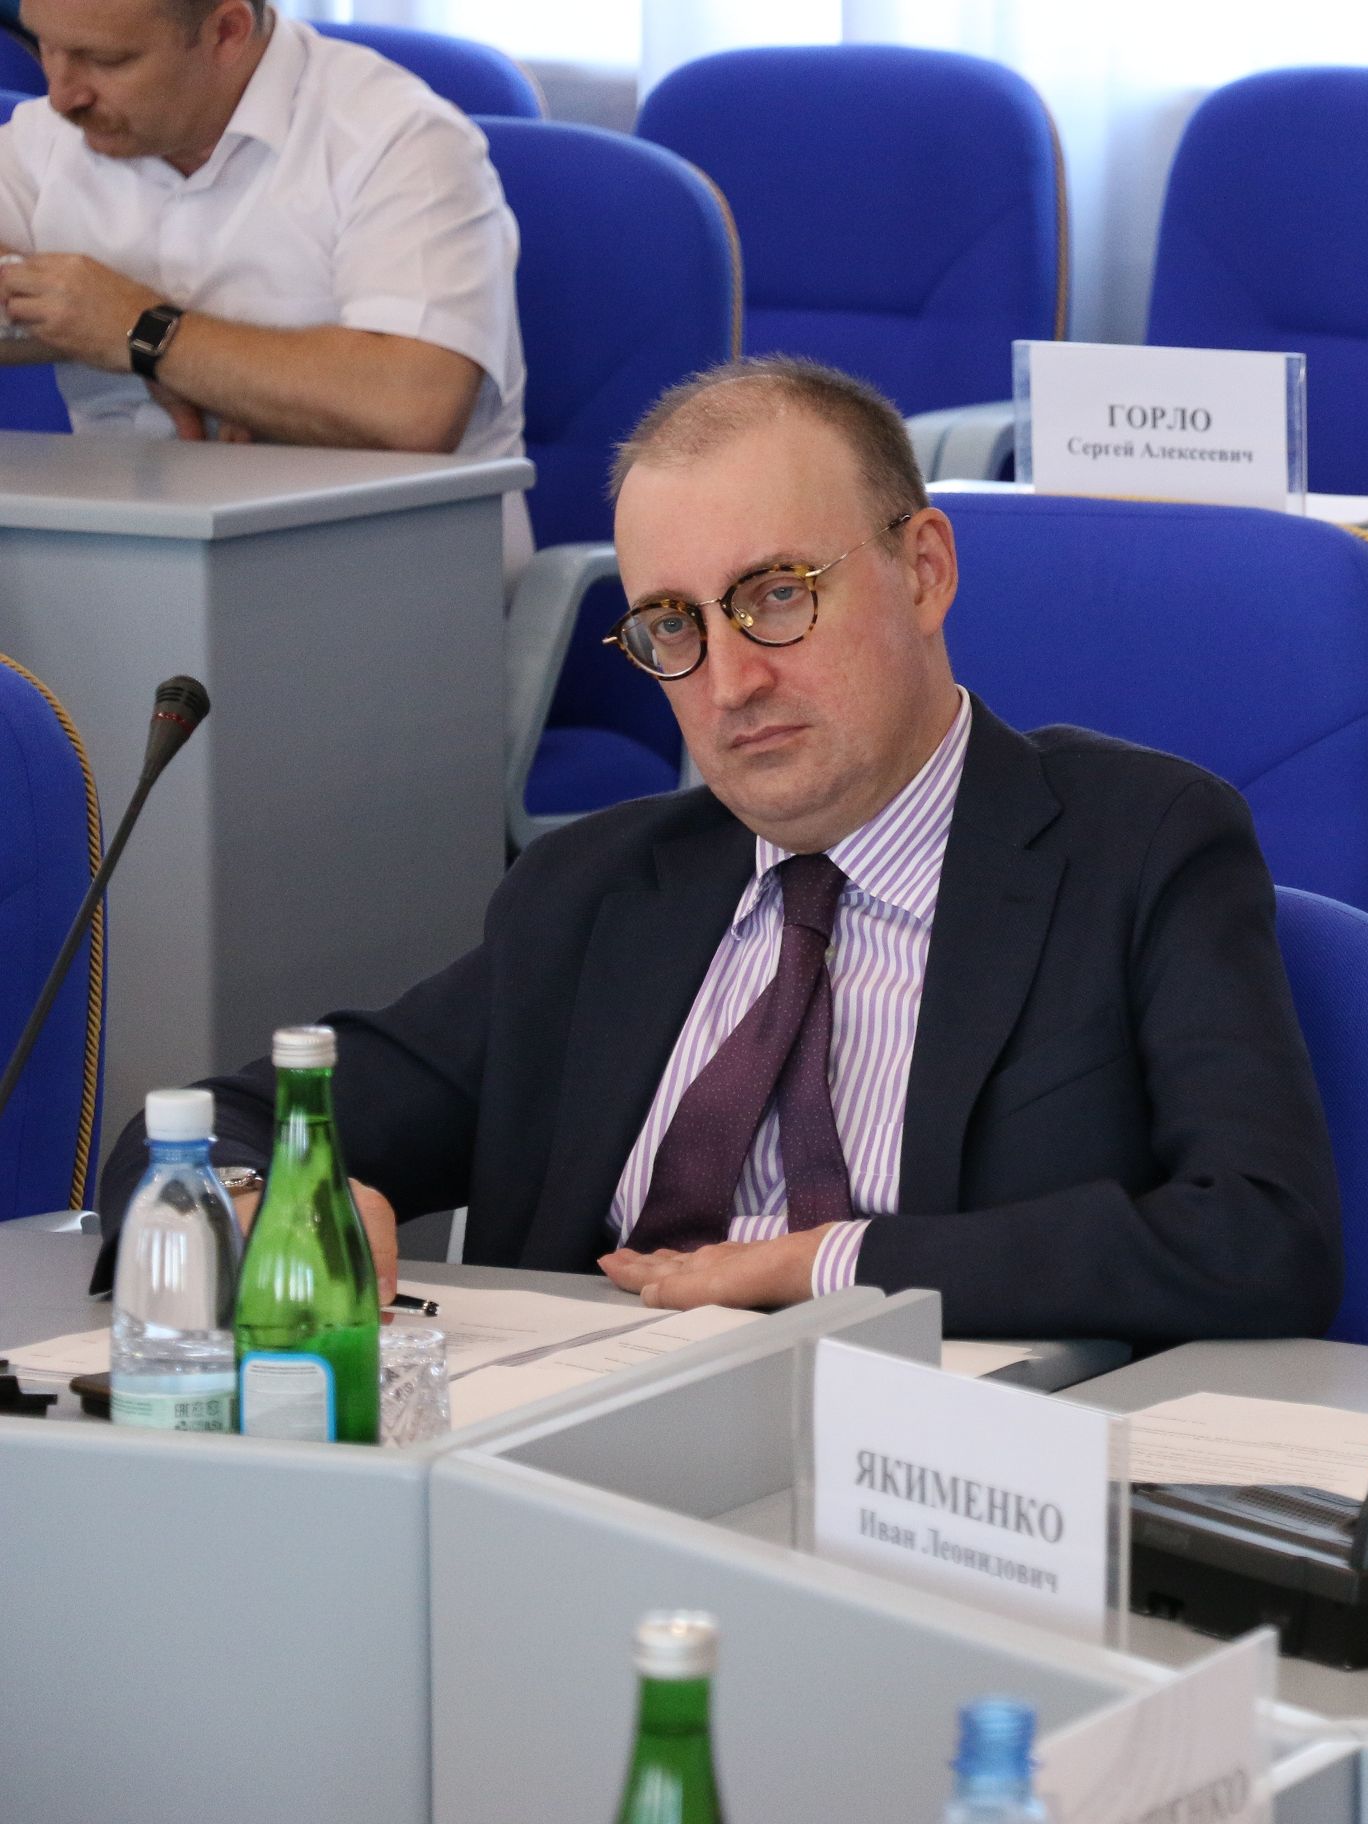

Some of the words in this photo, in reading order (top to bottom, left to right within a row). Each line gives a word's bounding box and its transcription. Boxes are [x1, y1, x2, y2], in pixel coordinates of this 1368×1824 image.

[1107, 403, 1213, 432] ГОРЛО
[1067, 437, 1134, 460] Сергей
[1140, 442, 1254, 464] Алексеевич
[854, 1449, 1065, 1544] ЯКИМЕНКО
[858, 1507, 916, 1550] Иван
[921, 1528, 1059, 1594] Леонидович
